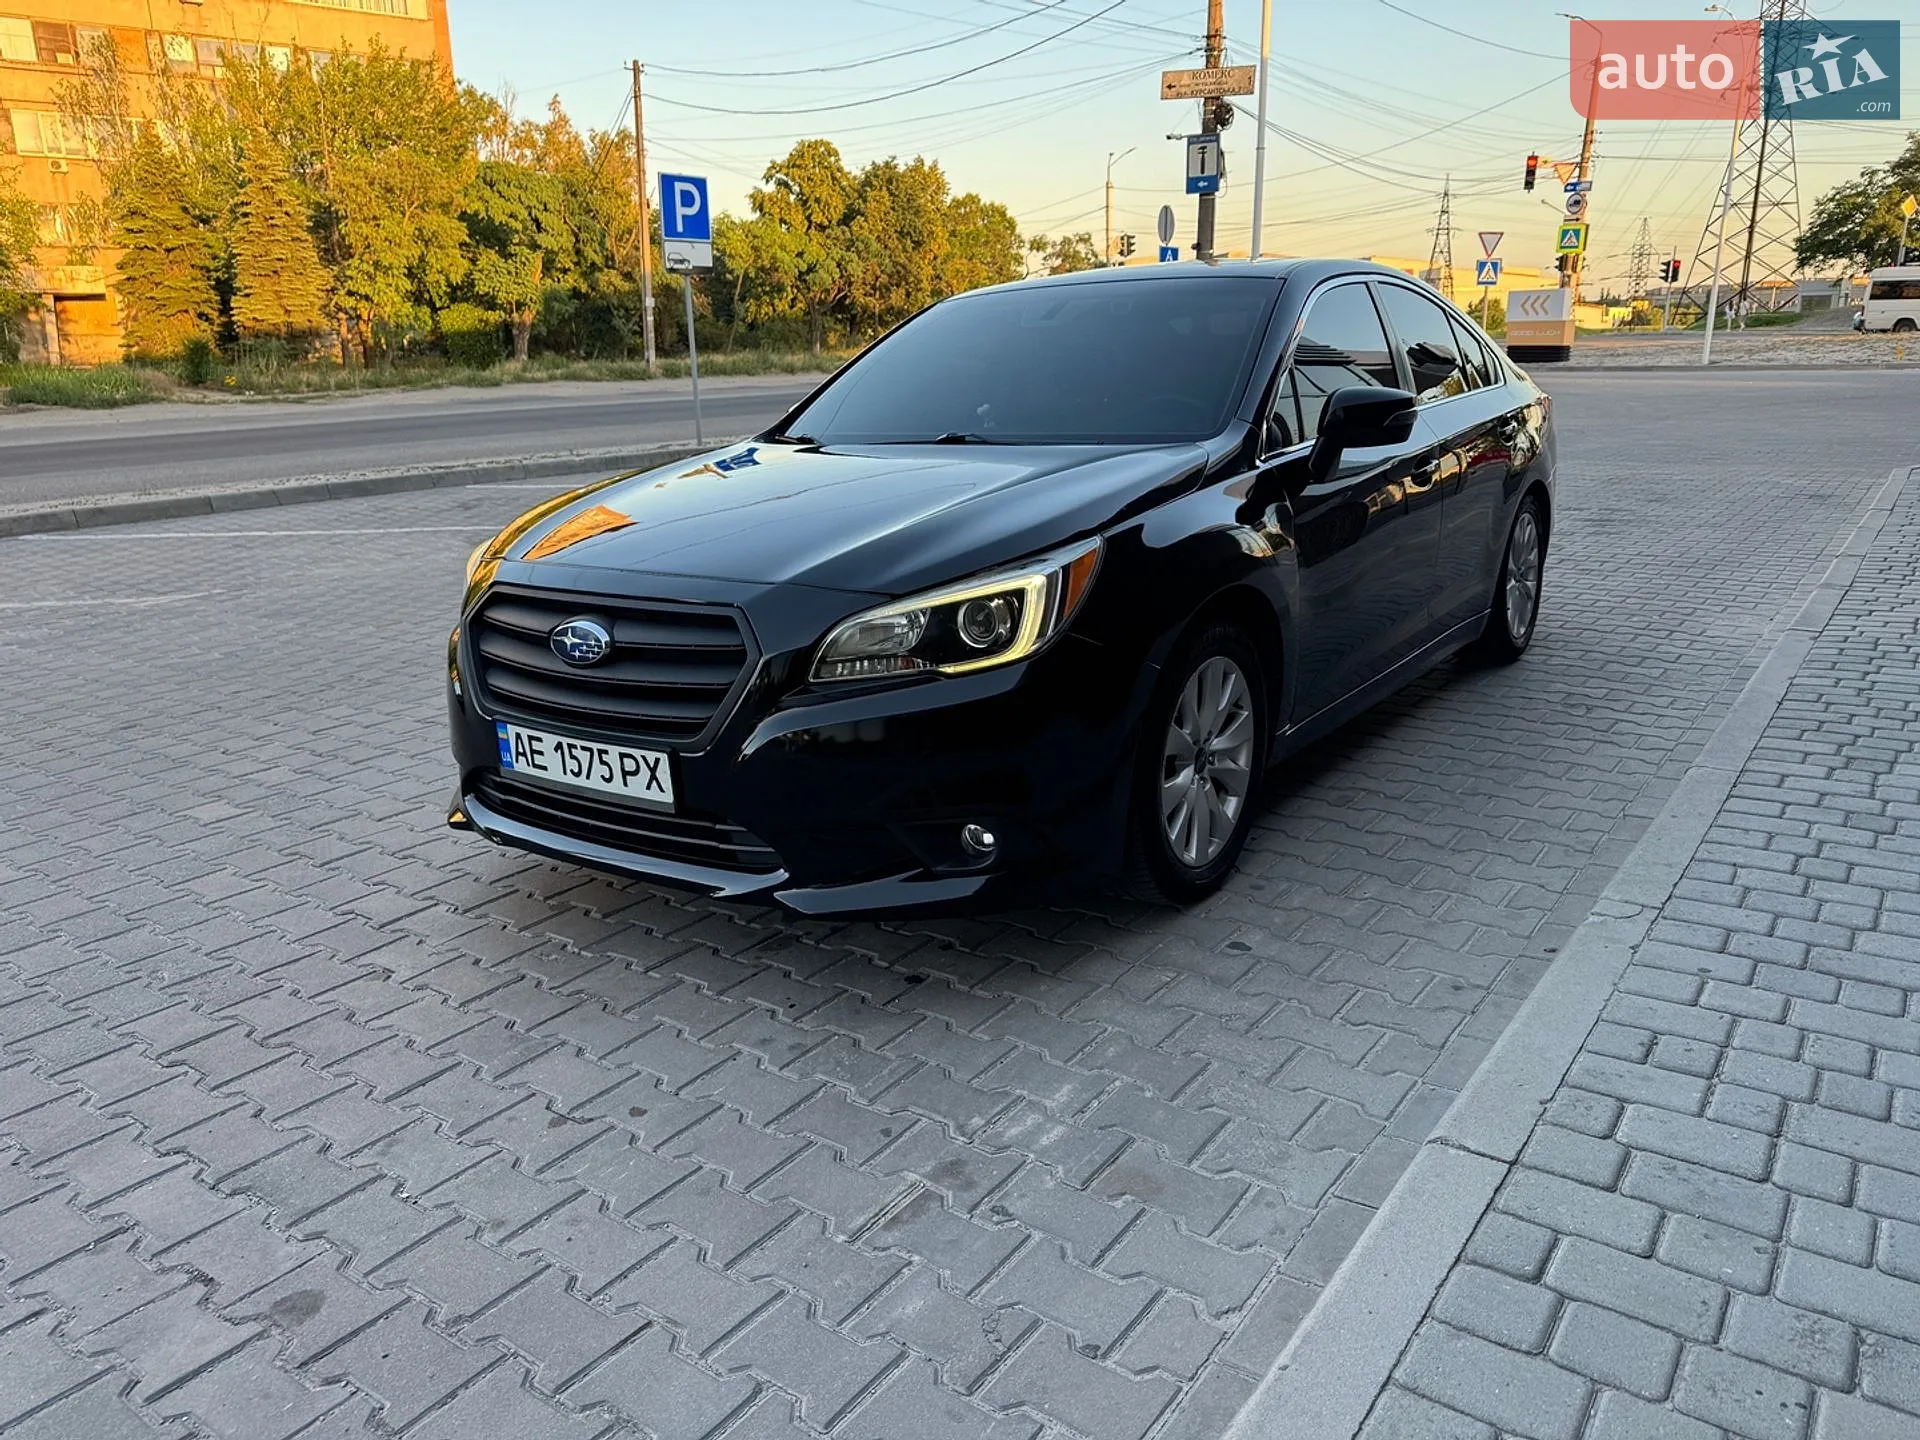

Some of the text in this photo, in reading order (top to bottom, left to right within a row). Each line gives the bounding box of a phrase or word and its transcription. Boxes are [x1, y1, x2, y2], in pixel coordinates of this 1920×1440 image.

[674, 181, 701, 233] P
[502, 751, 512, 763] UA
[514, 731, 666, 793] AE 1575 PX
